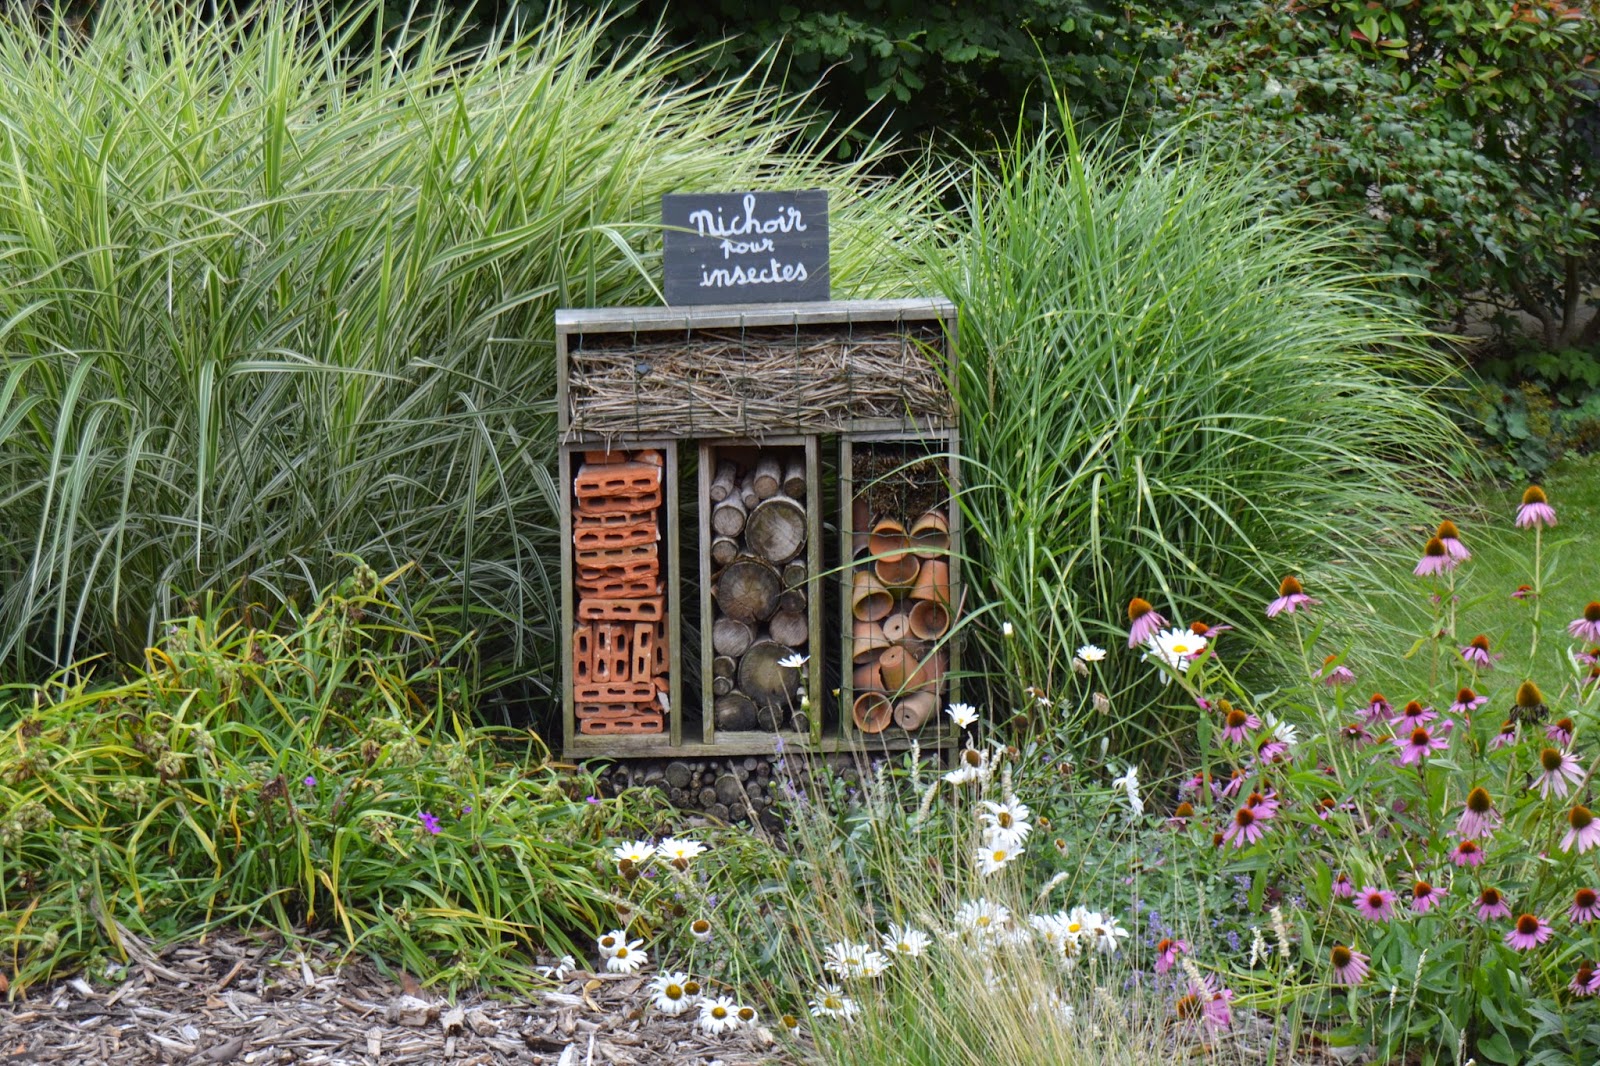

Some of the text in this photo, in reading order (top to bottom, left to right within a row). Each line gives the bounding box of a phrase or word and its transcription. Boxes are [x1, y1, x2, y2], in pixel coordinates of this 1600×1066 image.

[689, 194, 807, 237] Nichoir
[720, 237, 775, 259] pour
[700, 258, 808, 288] insectes
